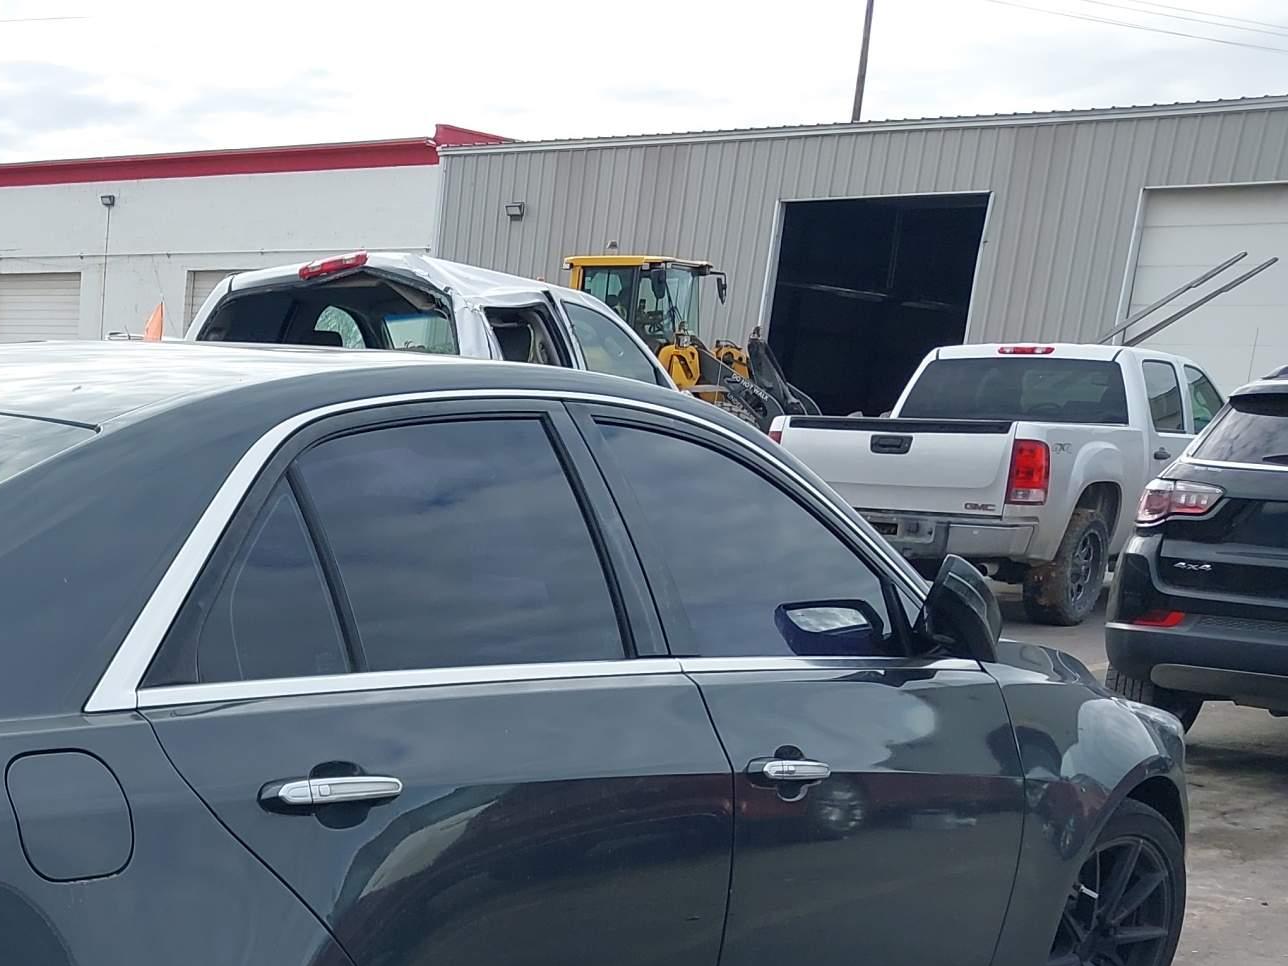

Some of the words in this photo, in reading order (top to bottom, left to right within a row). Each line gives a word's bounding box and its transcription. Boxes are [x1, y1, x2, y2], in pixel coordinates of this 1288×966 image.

[732, 373, 742, 382] DO
[741, 379, 754, 390] NOT
[753, 388, 769, 401] WALK
[964, 502, 997, 512] GMC
